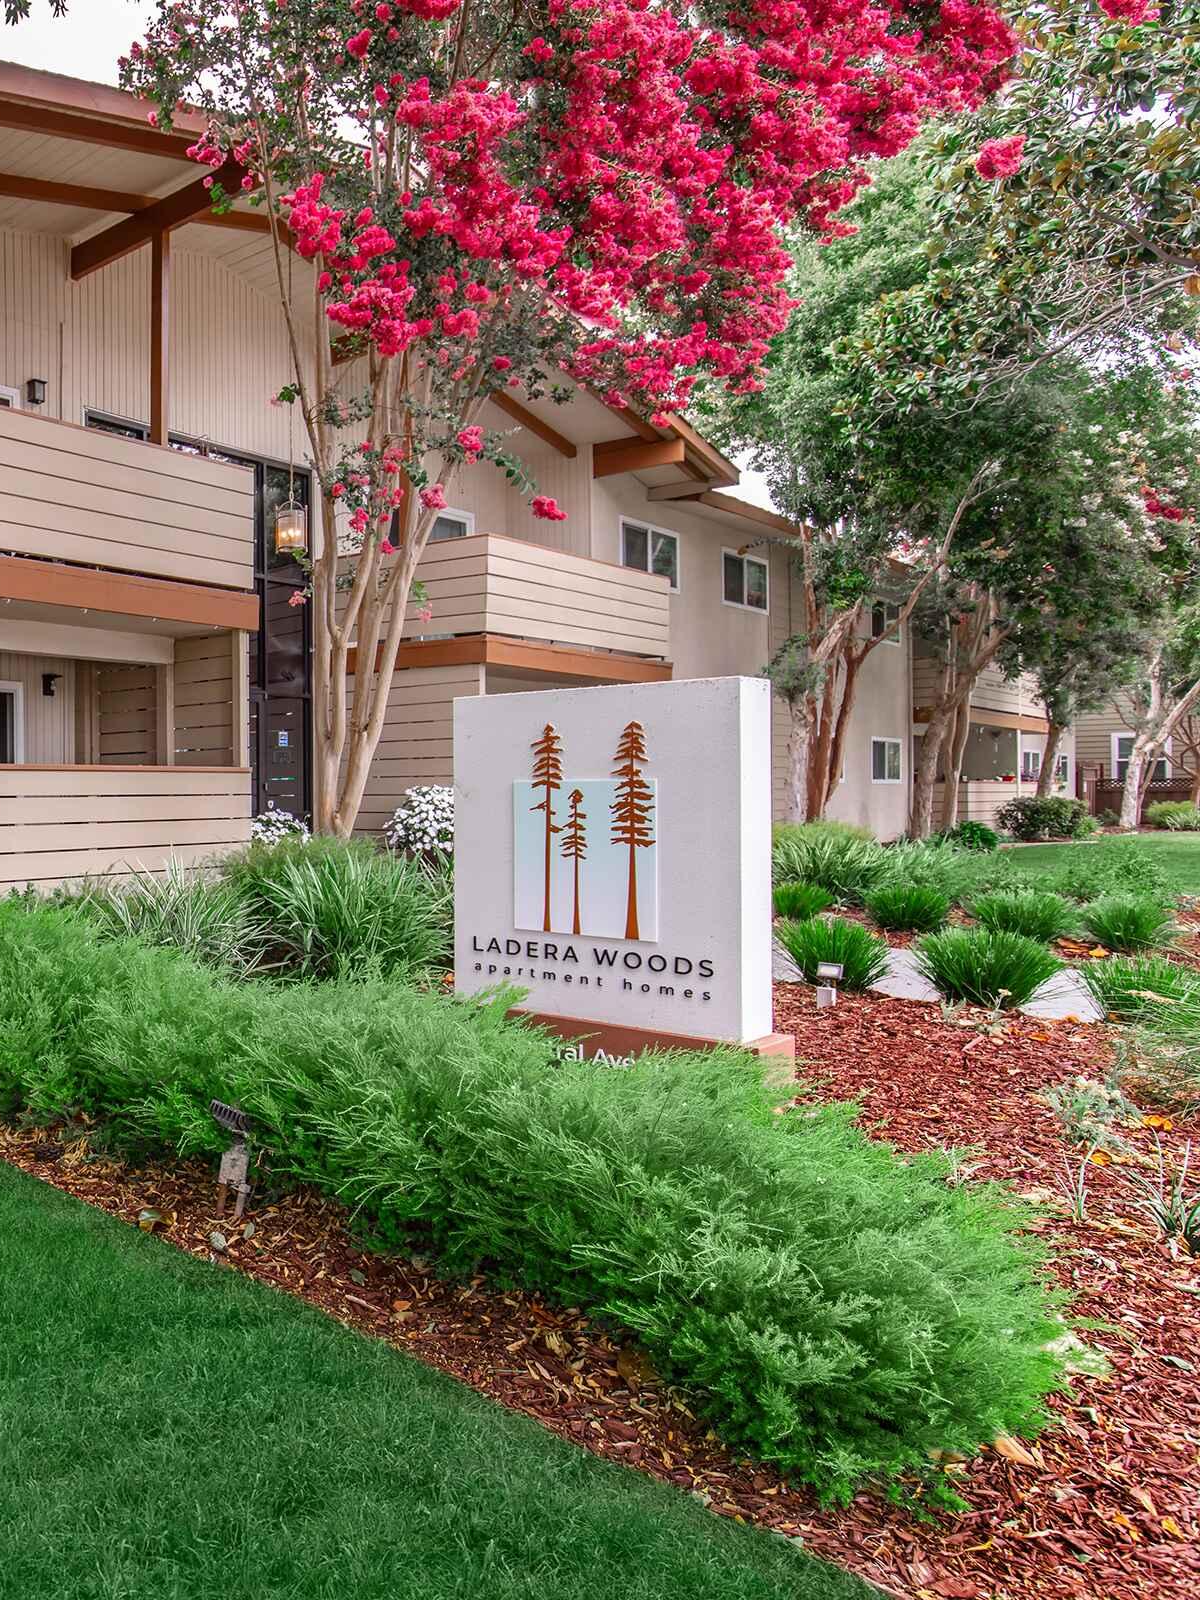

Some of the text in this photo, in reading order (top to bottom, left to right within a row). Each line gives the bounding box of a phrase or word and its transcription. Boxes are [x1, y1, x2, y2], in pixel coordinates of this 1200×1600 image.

[472, 935, 715, 978] LADERA WOODS
[474, 962, 712, 1001] apartment homes
